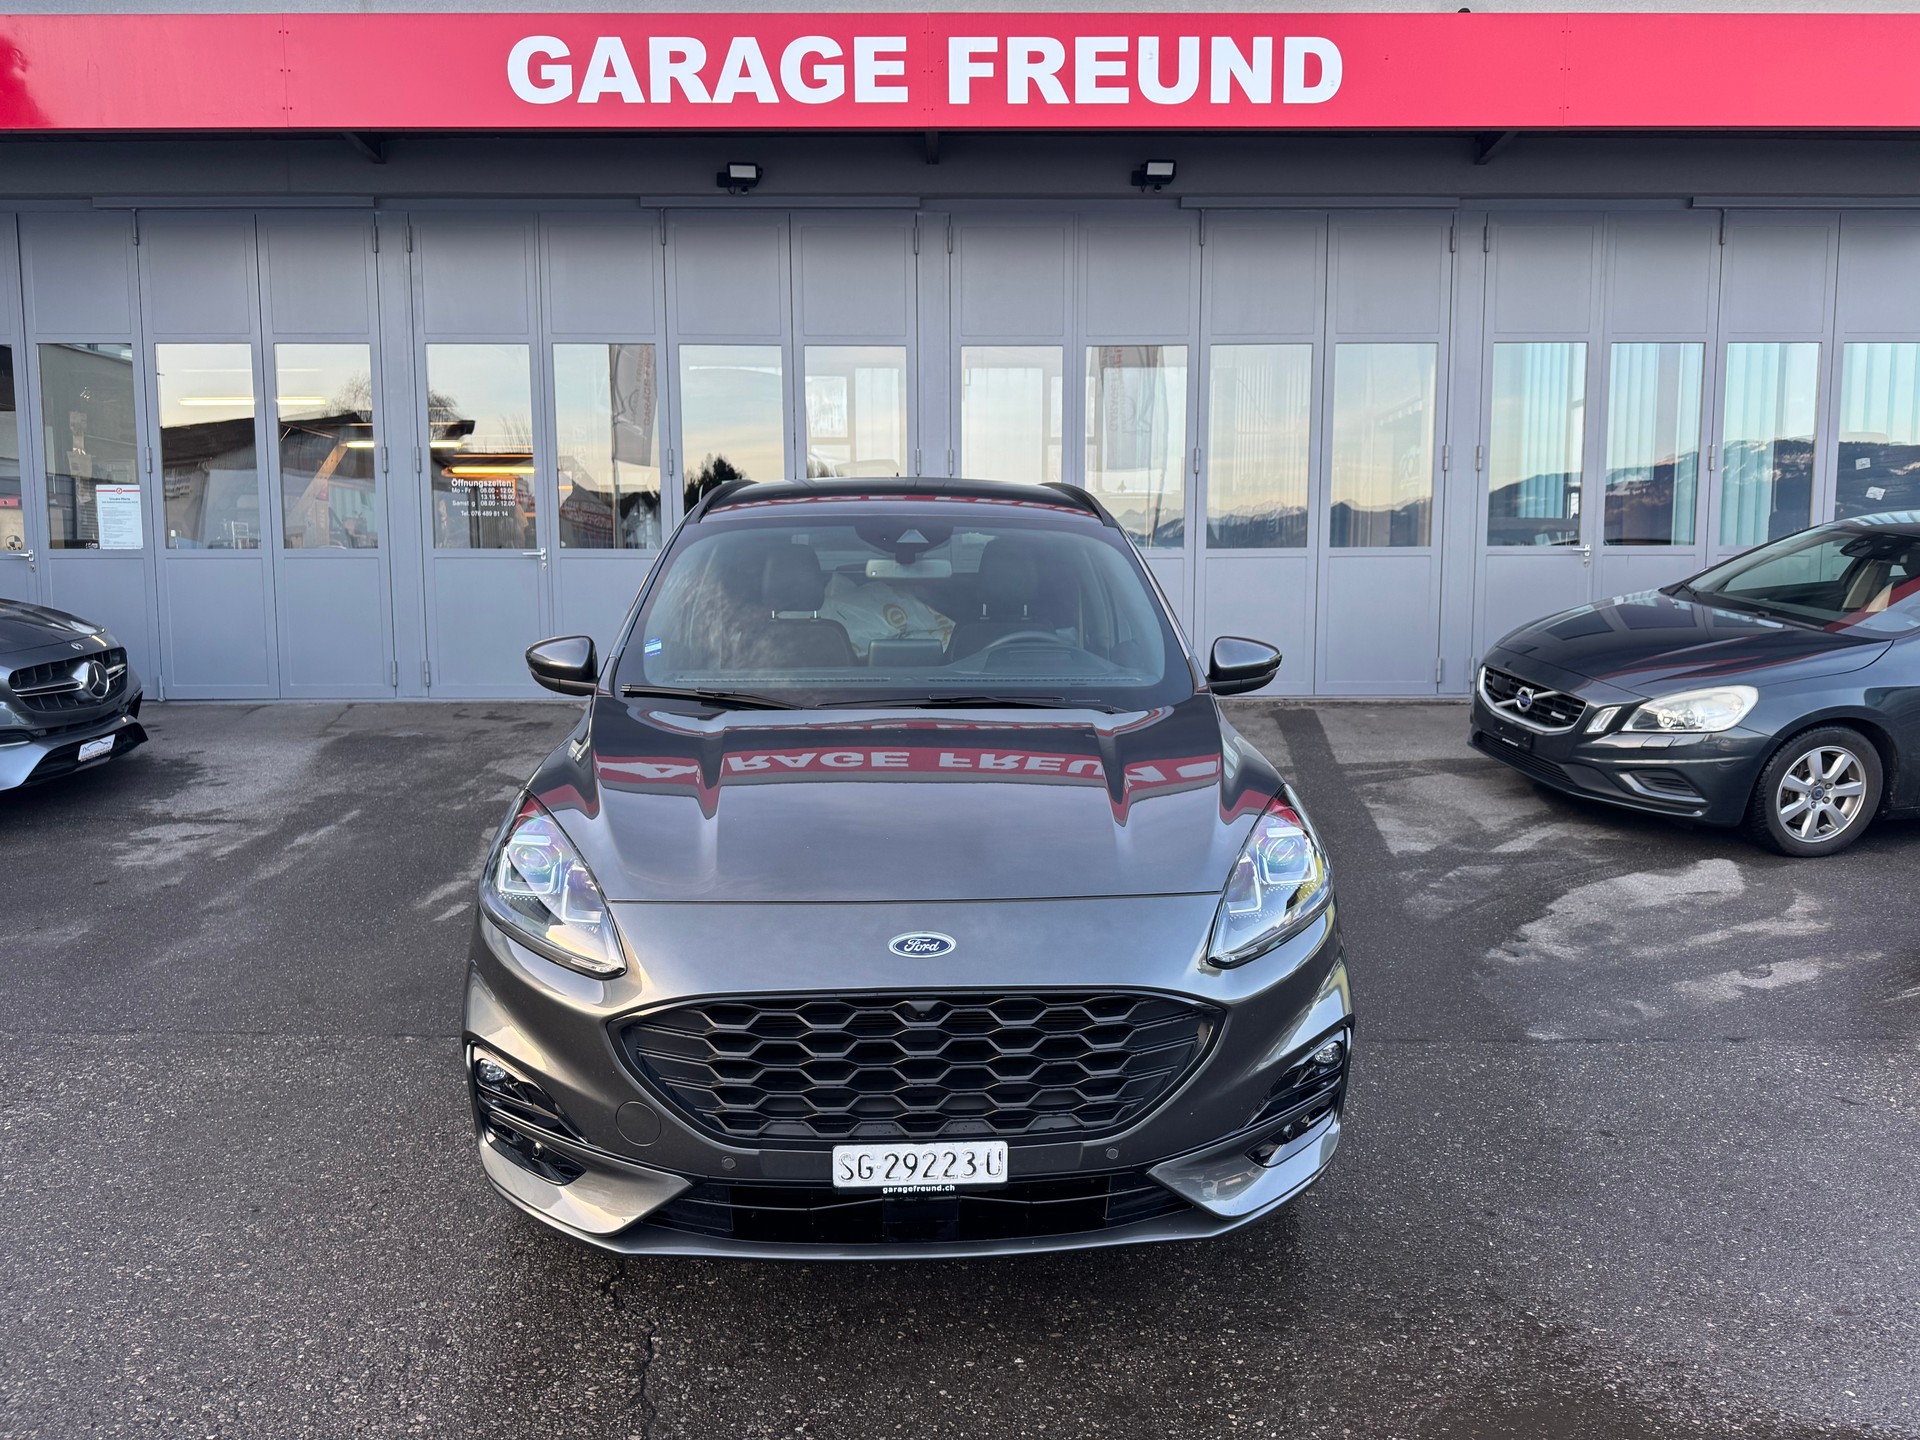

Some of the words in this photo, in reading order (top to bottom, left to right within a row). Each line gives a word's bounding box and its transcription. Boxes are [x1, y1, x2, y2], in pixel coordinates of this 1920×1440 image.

[506, 35, 908, 105] GARAGE
[948, 35, 1344, 105] FREUND
[451, 478, 514, 488] Öffnungszeiten:
[903, 938, 940, 952] Ford
[882, 1184, 956, 1194] garagefreund.ch
